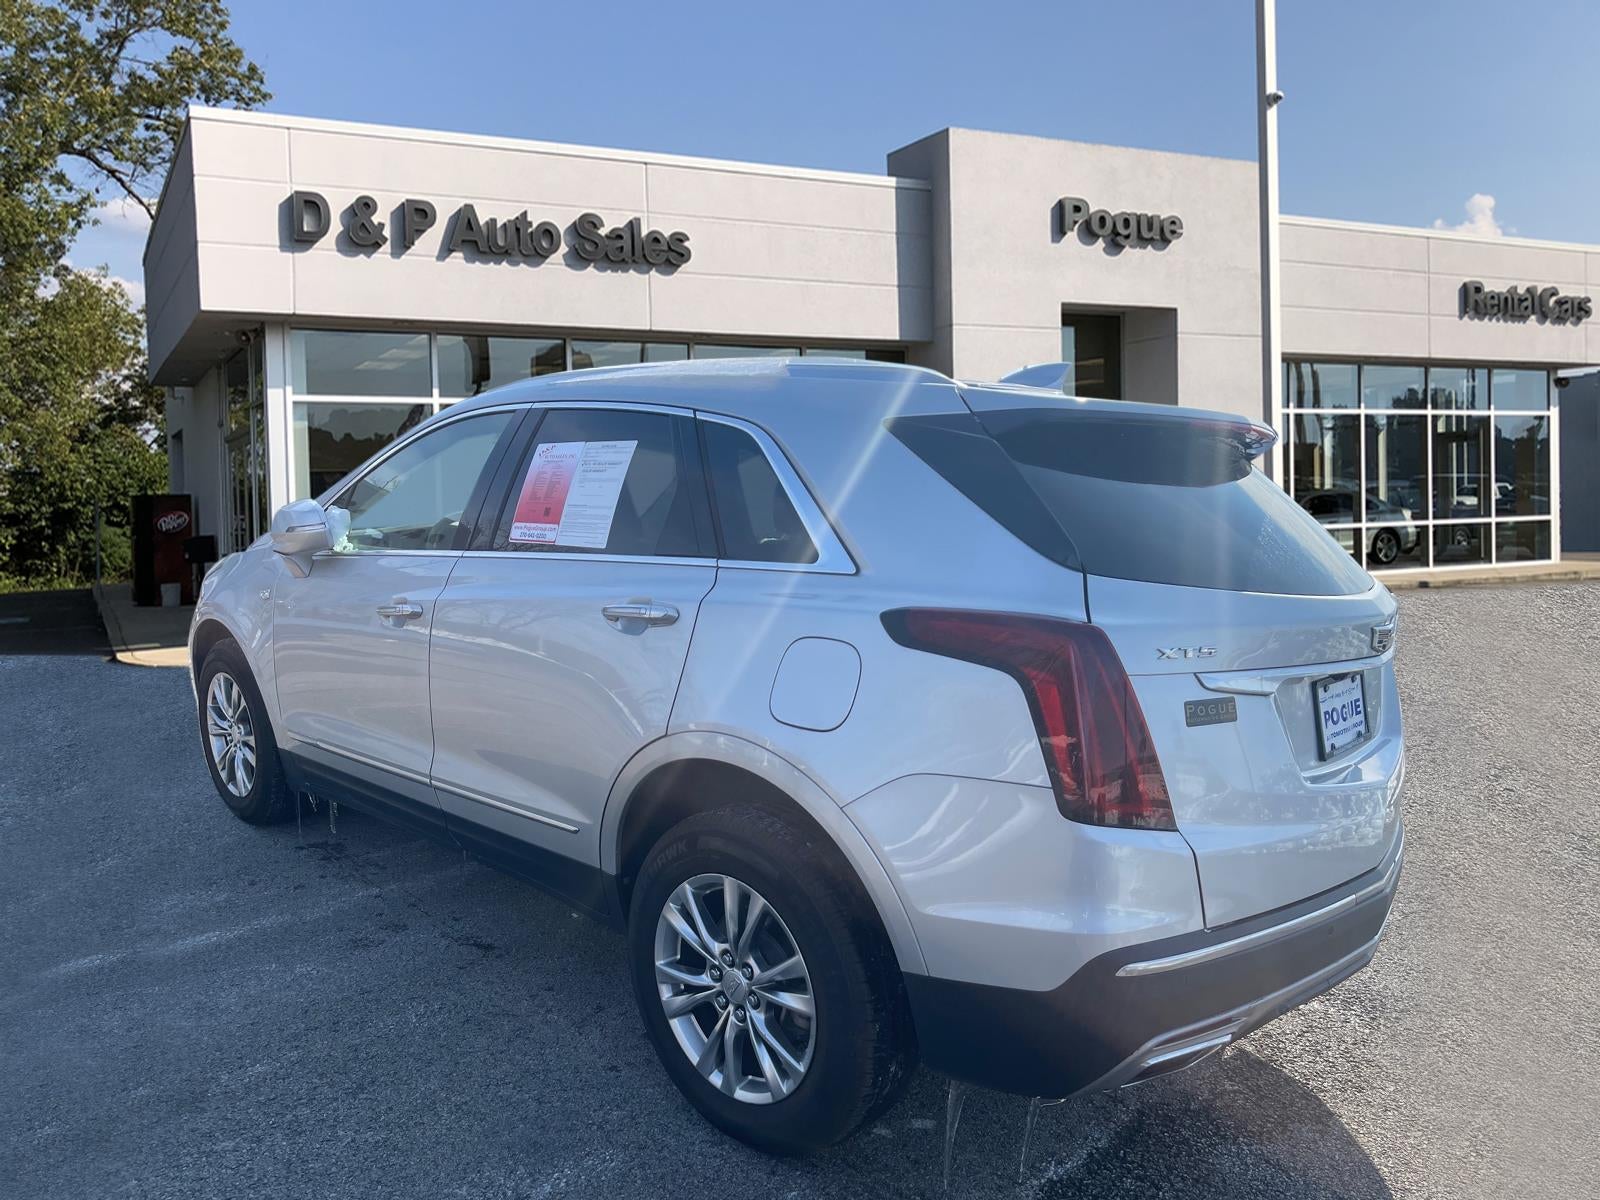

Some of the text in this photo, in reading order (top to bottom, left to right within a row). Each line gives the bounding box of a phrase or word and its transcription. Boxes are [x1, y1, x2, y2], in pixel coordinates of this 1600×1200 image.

[291, 190, 693, 267] D & P Auto Sales
[1060, 197, 1184, 247] Pogue
[1462, 281, 1593, 322] Rental Cars
[1156, 646, 1218, 660] XT5
[1186, 703, 1236, 718] POGUE
[1324, 698, 1362, 729] POGUE
